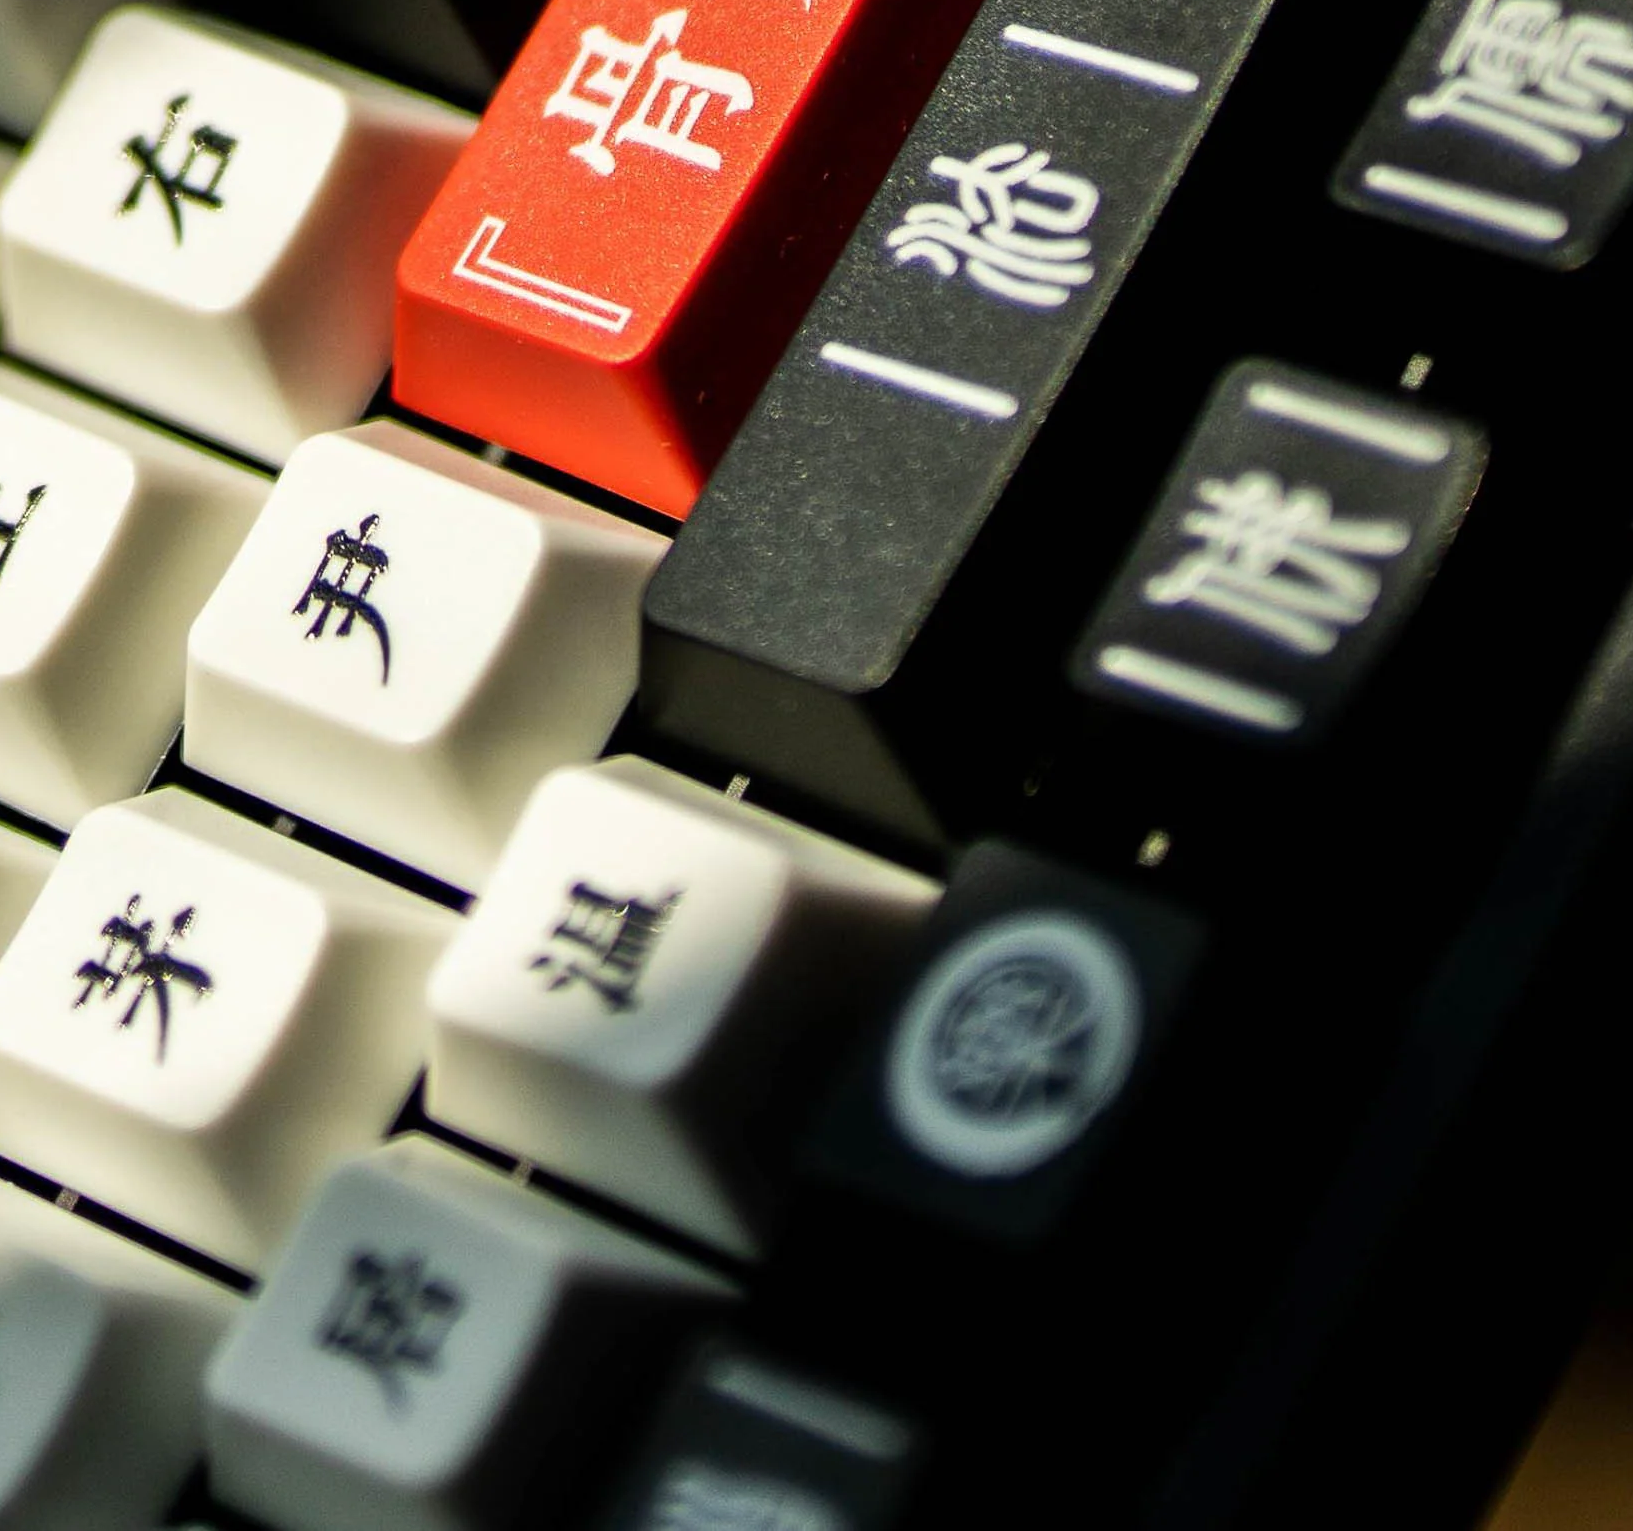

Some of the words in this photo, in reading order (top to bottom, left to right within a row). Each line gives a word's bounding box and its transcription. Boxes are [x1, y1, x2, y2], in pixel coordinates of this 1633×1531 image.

[119, 95, 237, 244] 右
[293, 514, 391, 683] 尹
[75, 895, 213, 1062] 茅
